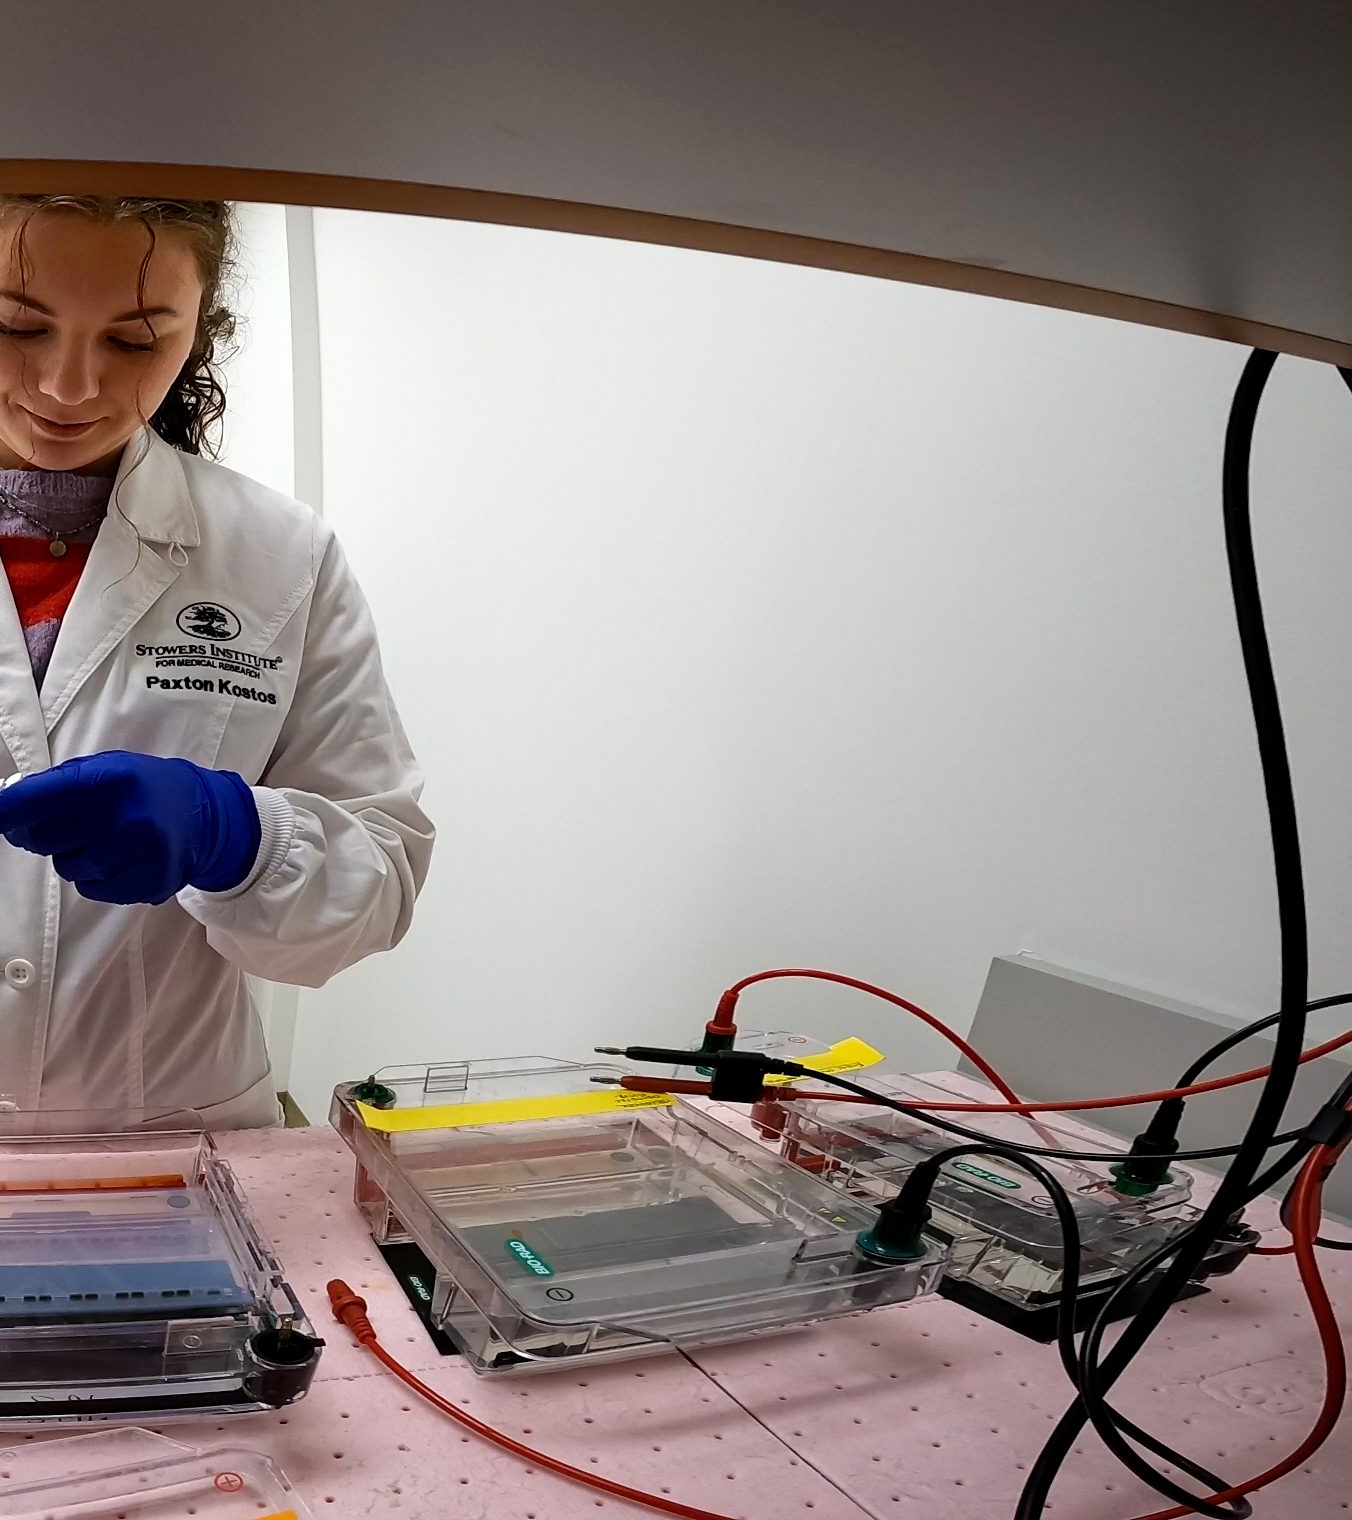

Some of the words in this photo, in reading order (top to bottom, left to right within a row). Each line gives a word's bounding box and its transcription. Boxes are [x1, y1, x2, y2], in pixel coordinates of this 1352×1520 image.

[155, 659, 176, 668] FOR
[176, 659, 217, 668] MEDICAL
[218, 662, 261, 679] RESEARCH
[146, 676, 214, 692] Paxton
[218, 678, 277, 705] Kostos
[509, 1240, 550, 1276] BIO-RAD
